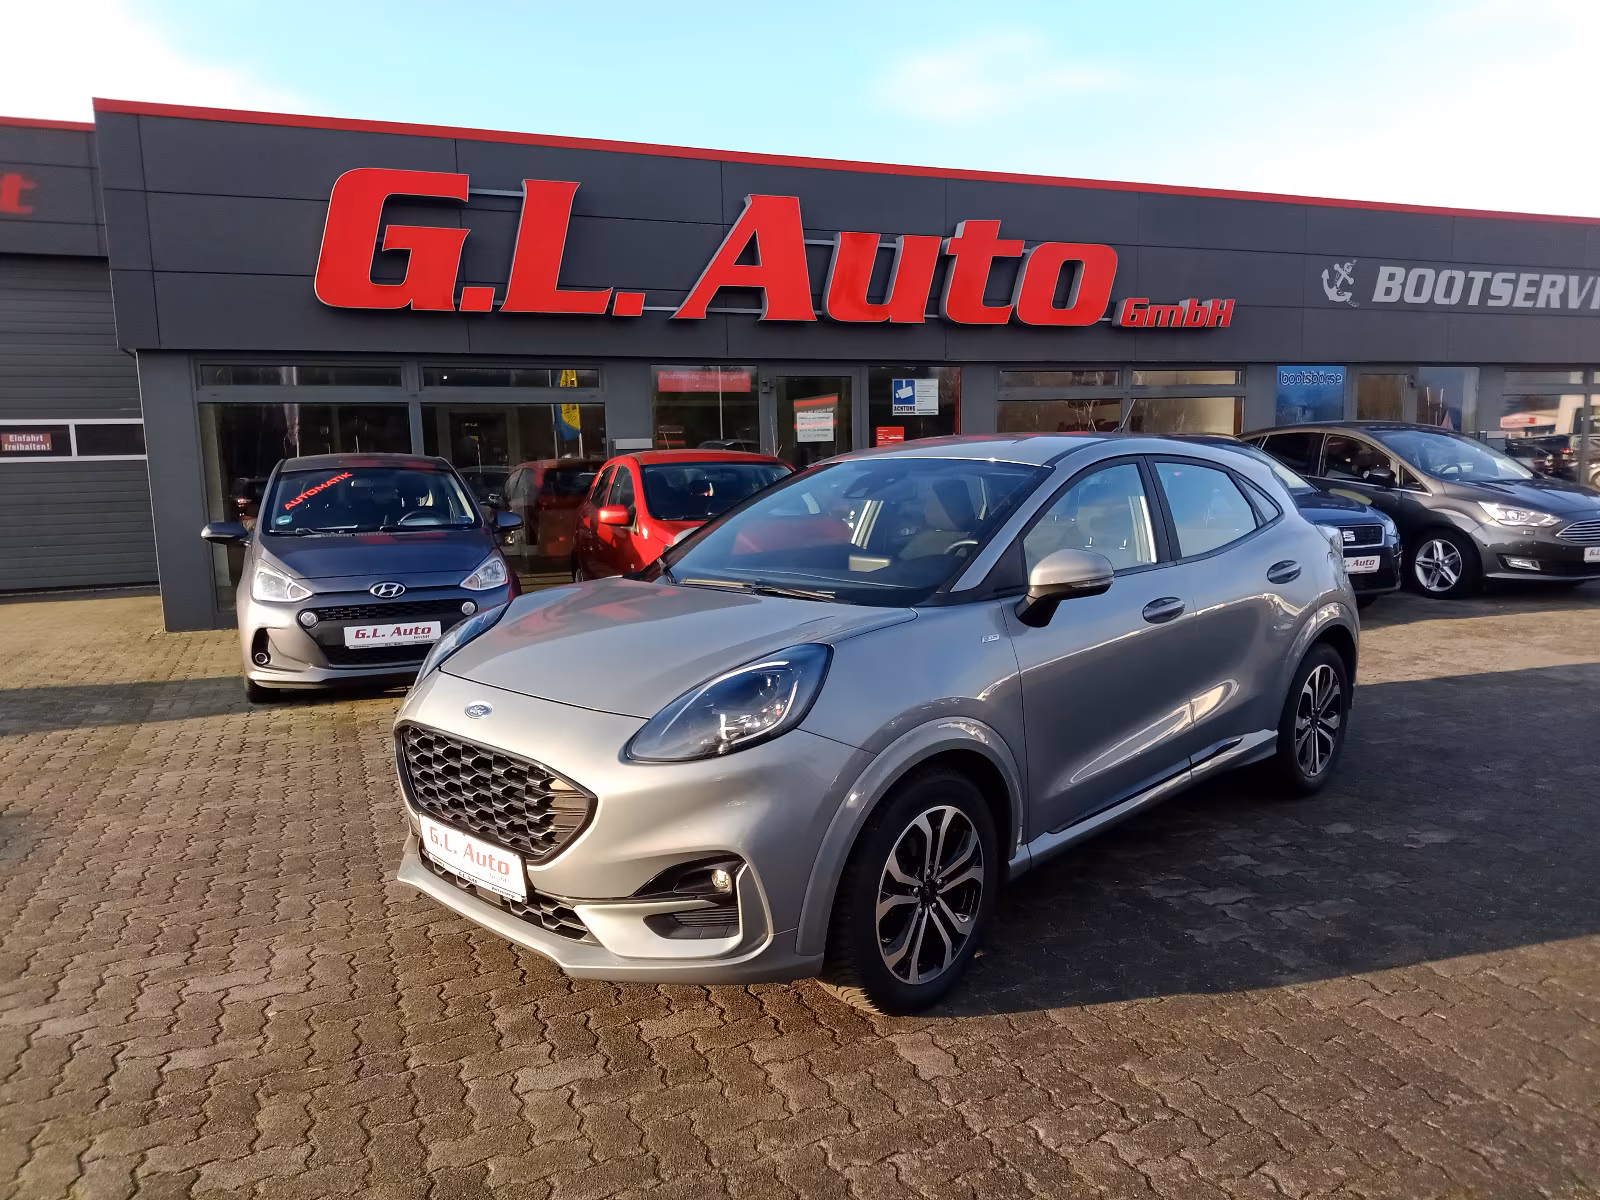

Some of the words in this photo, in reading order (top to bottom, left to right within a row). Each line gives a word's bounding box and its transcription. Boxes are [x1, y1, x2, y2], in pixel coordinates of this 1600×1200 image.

[313, 168, 646, 318] G.L.
[670, 193, 1120, 328] Auto
[1116, 297, 1236, 328] GmbH
[1280, 370, 1342, 386] bootsbörse
[9, 434, 43, 442] Einfahrt
[4, 443, 50, 451] freihalten!
[285, 472, 353, 510] AUTOMATIK
[1352, 559, 1376, 567] Auto
[354, 628, 386, 640] G.L.
[390, 625, 432, 637] Auto
[429, 826, 458, 855] G.L.
[463, 843, 511, 876] Auto
